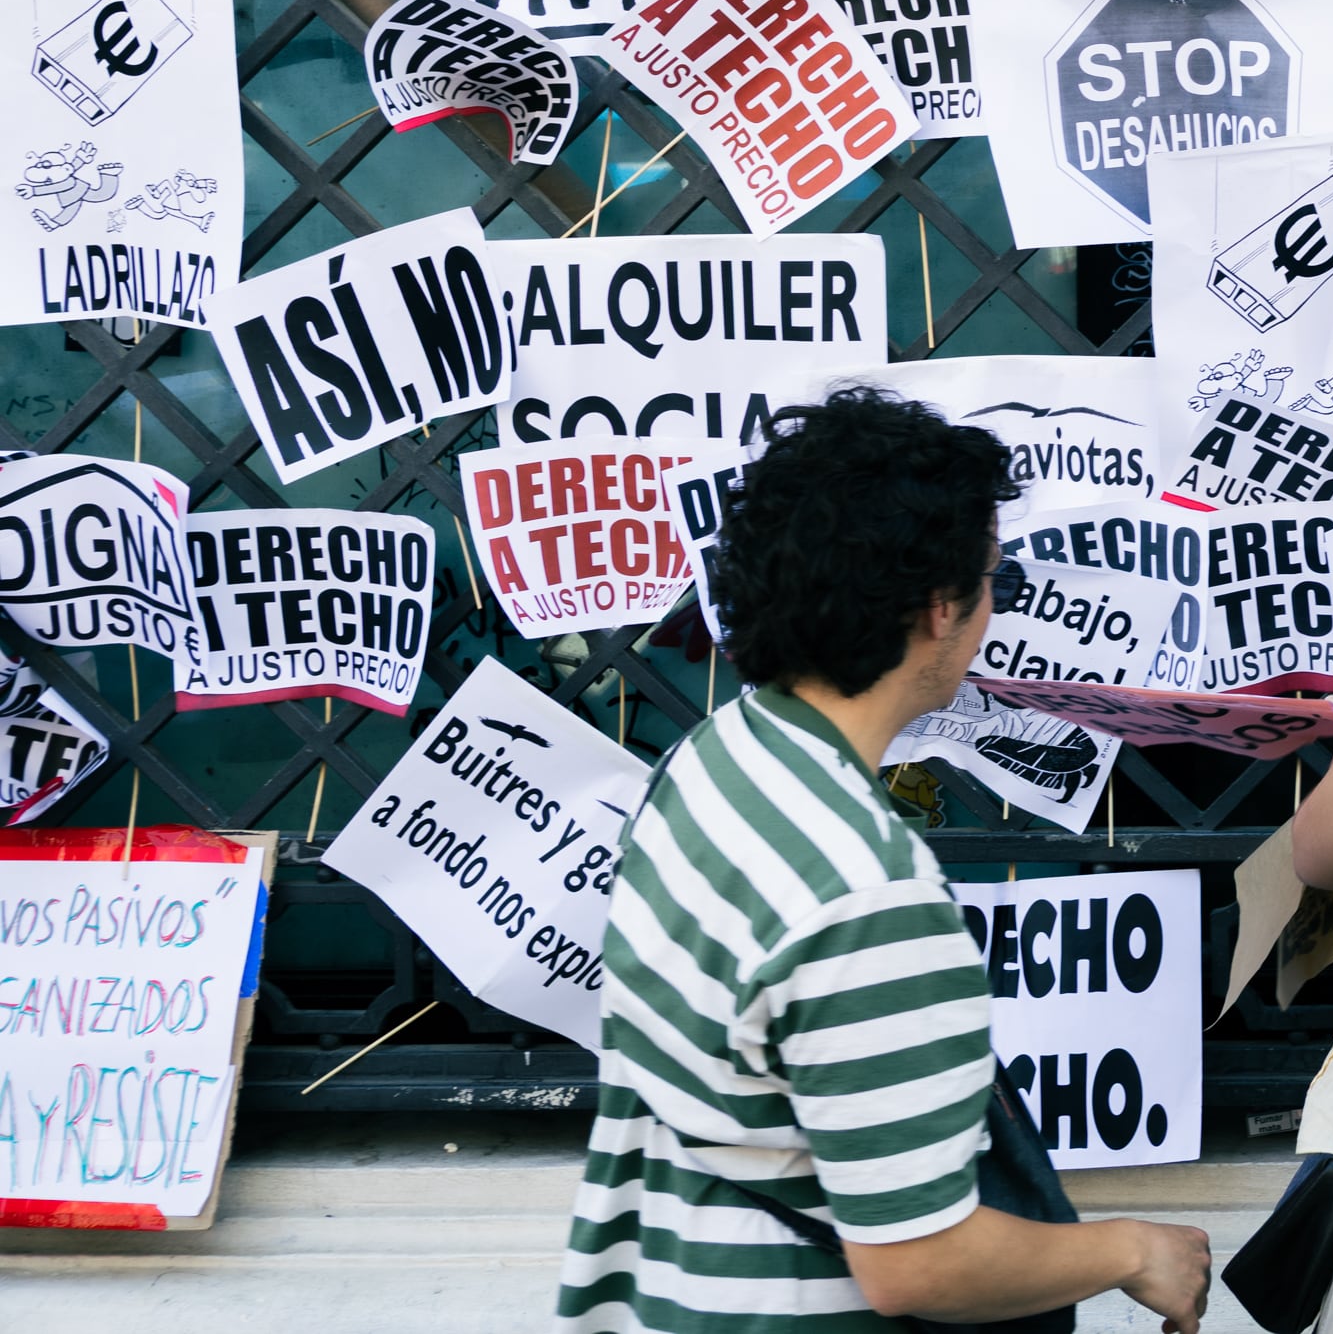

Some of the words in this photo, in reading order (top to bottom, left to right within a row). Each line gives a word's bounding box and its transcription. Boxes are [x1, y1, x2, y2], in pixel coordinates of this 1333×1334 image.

[681, 10, 843, 201] TECHO
[1077, 39, 1271, 101] STOP
[634, 43, 720, 115] JUSTO
[710, 114, 796, 225] PRECIO!
[235, 254, 424, 465] ASÍ,
[393, 246, 503, 403] NO
[0, 504, 180, 606] DIGNA
[191, 526, 428, 593] DERECHO
[37, 598, 177, 653] JUSTO
[219, 649, 326, 686] JUSTO
[336, 651, 413, 697] PRECIO!
[236, 587, 422, 659] TECHO
[424, 716, 563, 830] Buitres
[372, 794, 396, 826] a
[395, 797, 489, 890] fondo
[477, 880, 536, 939] nos
